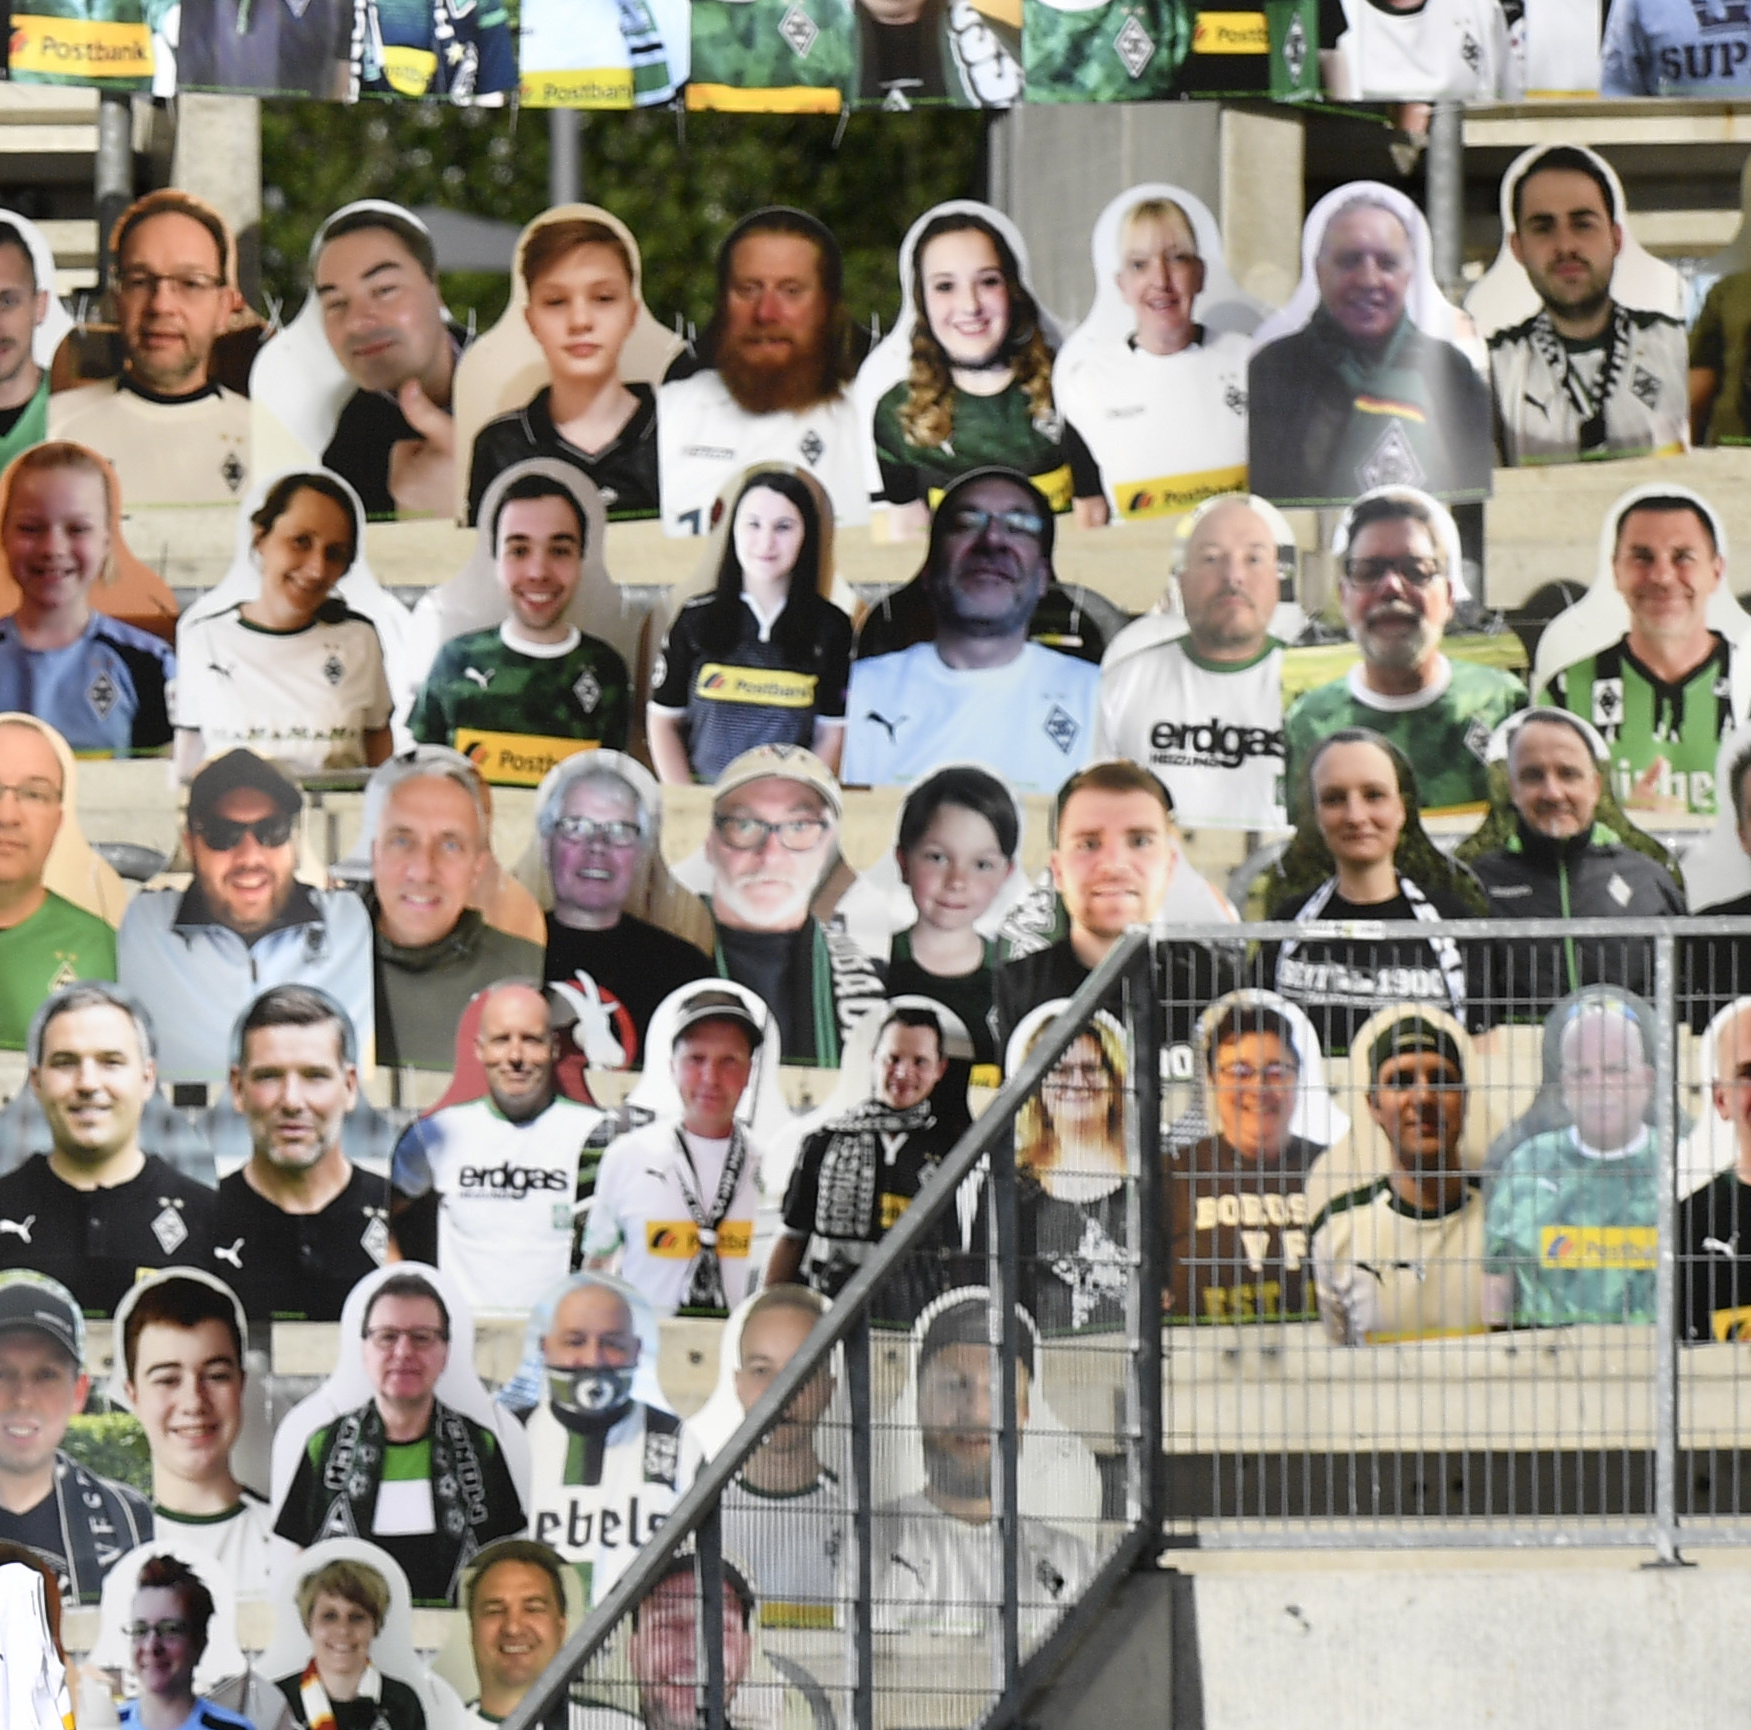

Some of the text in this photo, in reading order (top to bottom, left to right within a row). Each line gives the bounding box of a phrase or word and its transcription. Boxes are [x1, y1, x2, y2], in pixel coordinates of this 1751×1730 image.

[42, 35, 147, 62] Postbank
[1659, 42, 1748, 80] SUP
[1150, 716, 1283, 769] erdgas
[460, 1160, 569, 1201] erdgas
[536, 1492, 669, 1549] ebels
